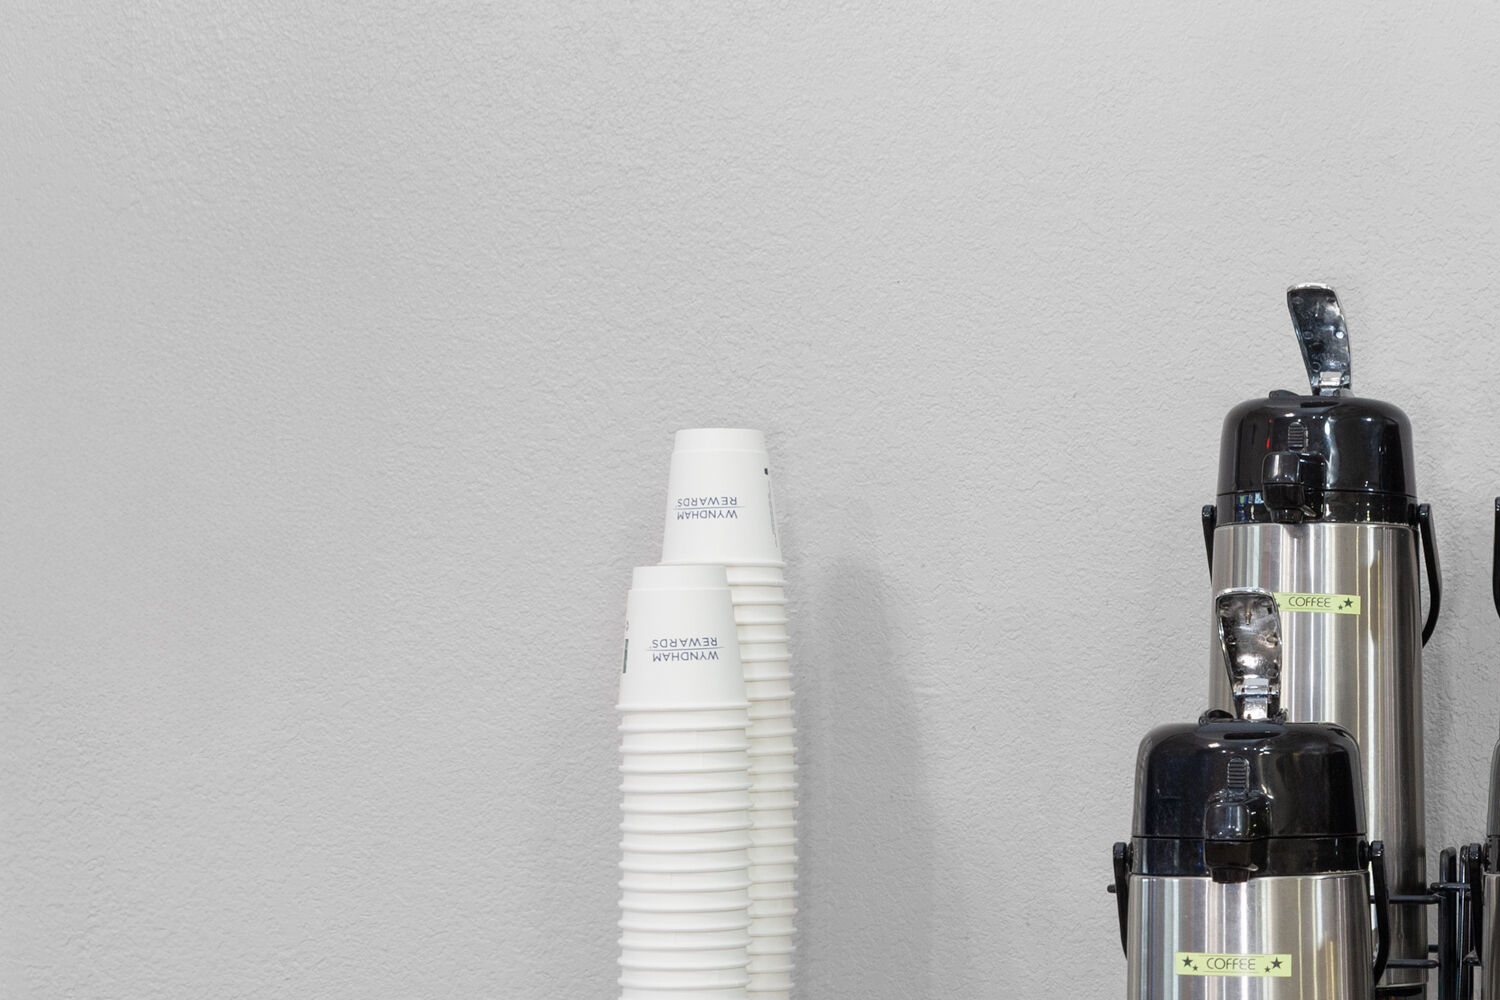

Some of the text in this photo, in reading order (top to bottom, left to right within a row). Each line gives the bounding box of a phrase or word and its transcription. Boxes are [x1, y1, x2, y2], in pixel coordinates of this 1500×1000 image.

[677, 496, 738, 507] REWARDS
[677, 510, 738, 520] WYNDHAM
[1288, 595, 1332, 608] COFFEE
[652, 637, 718, 649] REWARDS
[652, 651, 719, 662] WYNDHAM
[1206, 957, 1256, 971] COFFEE
